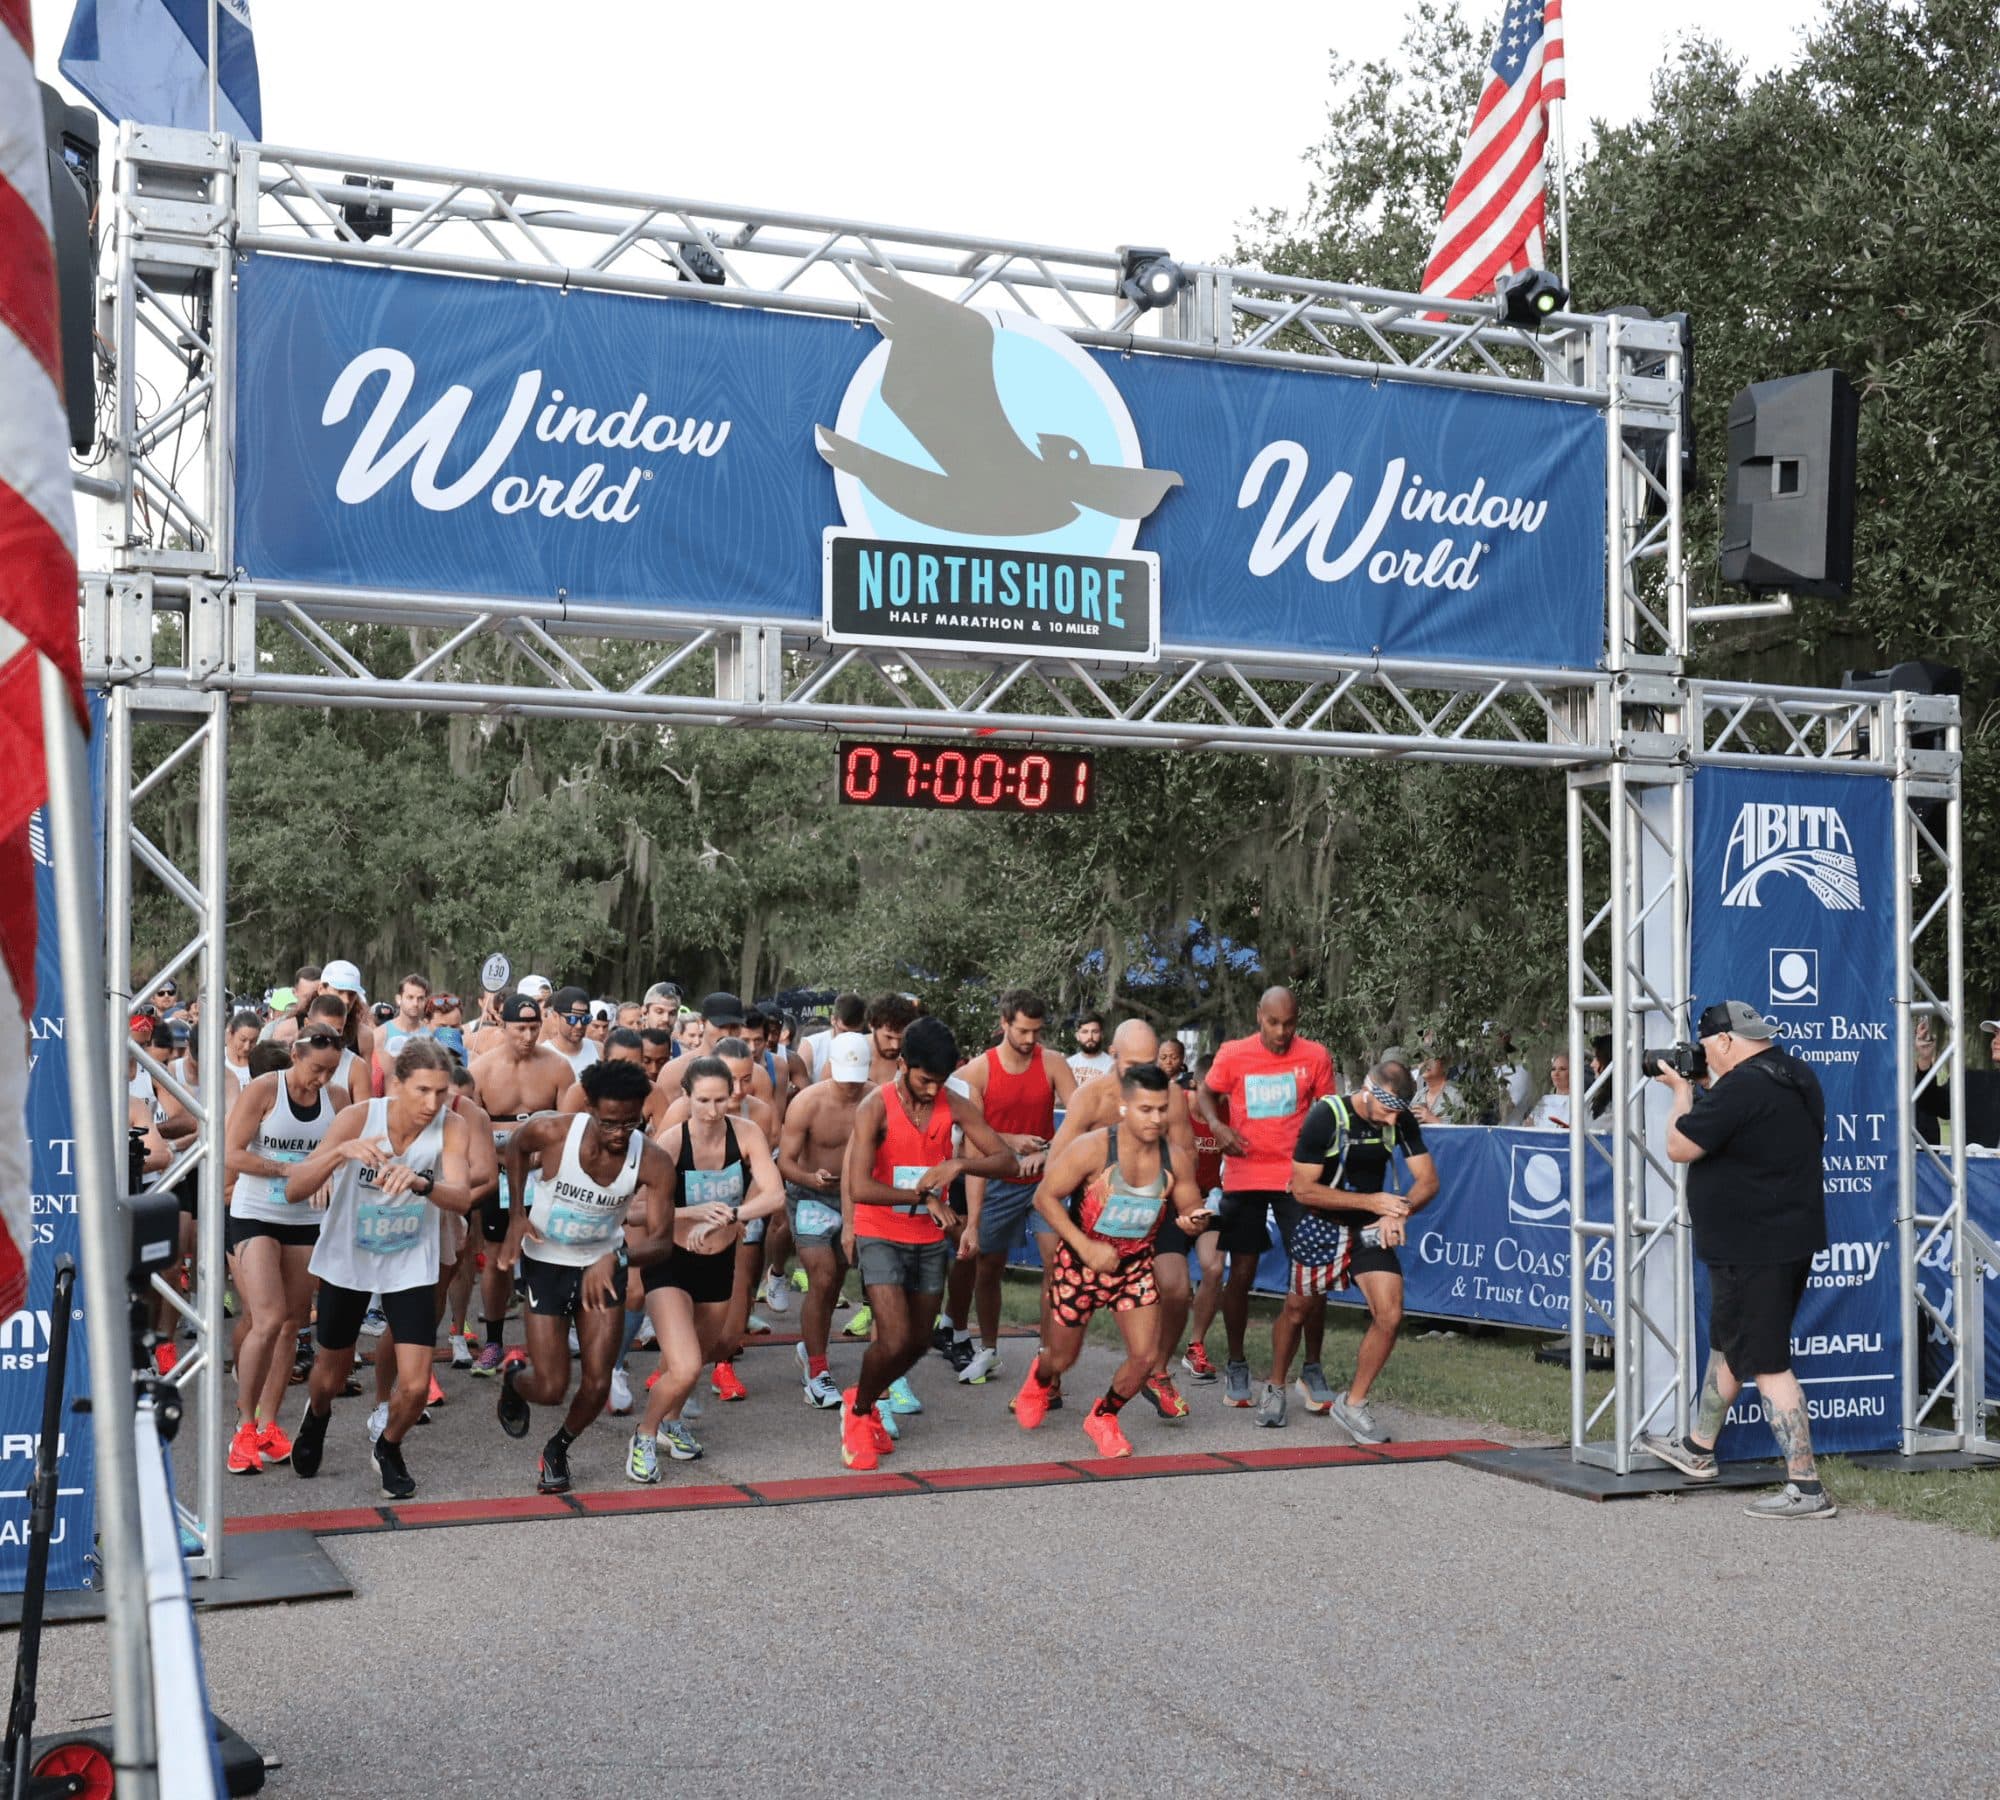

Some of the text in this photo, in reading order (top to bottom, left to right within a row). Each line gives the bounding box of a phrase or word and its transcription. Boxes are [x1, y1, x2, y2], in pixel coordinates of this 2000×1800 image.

[321, 347, 731, 511] Window
[1237, 440, 1548, 581] Window
[858, 549, 1126, 629] NORTHSHORE
[889, 610, 1100, 636] HALF MARATHON & 10 MILER
[1721, 802, 1853, 896] ABITA
[264, 1135, 304, 1150] POWER
[1855, 1155, 1888, 1171] ENT
[555, 1181, 594, 1204] POWER
[690, 1176, 742, 1203] 1368
[361, 1216, 419, 1237] 1840
[1451, 1275, 1467, 1298] &
[1473, 1276, 1524, 1305] Trust
[1807, 1396, 1886, 1420] SUBARU
